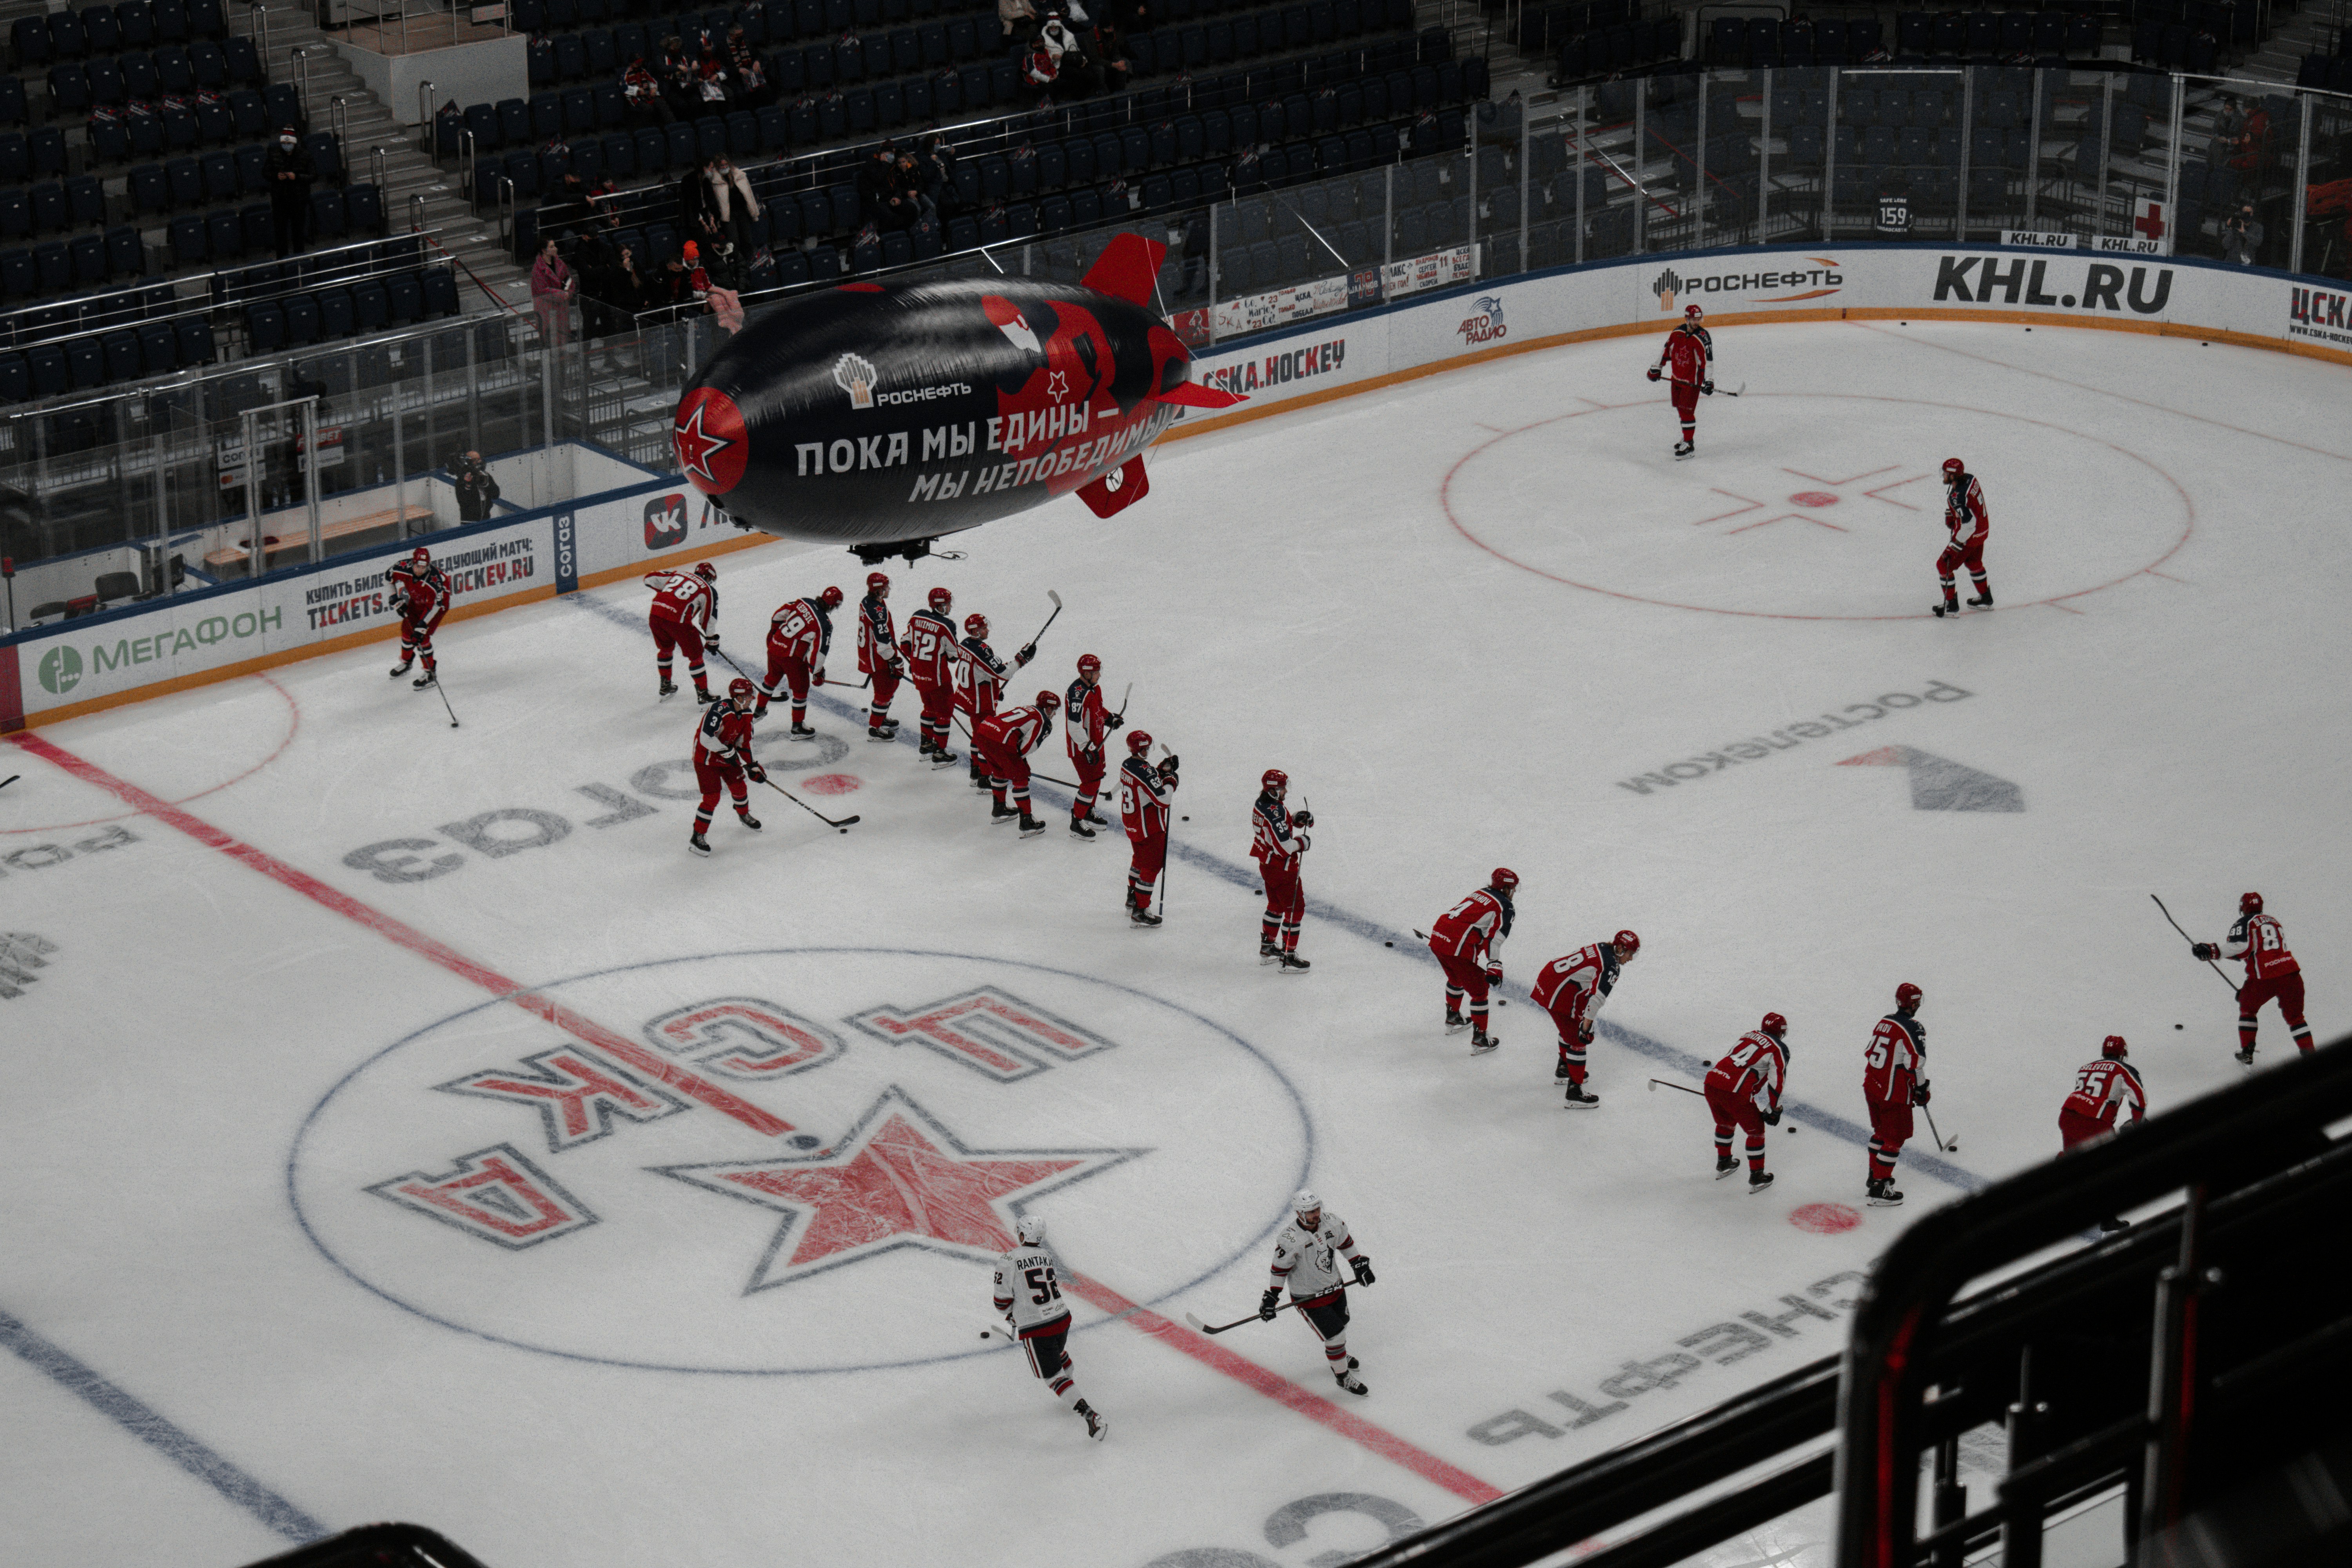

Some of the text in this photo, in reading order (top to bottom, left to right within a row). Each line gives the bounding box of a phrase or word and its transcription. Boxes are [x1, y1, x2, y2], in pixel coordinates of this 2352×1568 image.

[1880, 208, 1906, 225] 159
[2011, 232, 2068, 247] KHL.RU
[2102, 238, 2159, 254] KHL.RU
[1440, 256, 1447, 268] 11
[1686, 270, 1843, 294] РОСНЕФТЬ
[1933, 256, 2173, 314] KHL.RU
[1269, 295, 1278, 303] 23
[1252, 320, 1262, 328] 23
[1457, 315, 1489, 336] АВТО
[1466, 324, 1506, 346] РАДИО
[1203, 339, 1345, 394] CSKA.HOCKEY
[877, 383, 971, 407] РОСНЕФТЬ
[795, 432, 909, 476] ПОКА
[922, 421, 975, 461] МЫ
[986, 401, 1089, 454] ЕДИНЫ
[907, 470, 969, 502] МЫ
[650, 508, 681, 532] VK
[431, 538, 533, 573] ЛЕДУЮЩИЙ МАТЧ:
[558, 516, 573, 577] согаз
[306, 572, 385, 606] КУПИТЬ БИЛЕ
[662, 575, 699, 600] 28
[858, 621, 866, 648] 3
[878, 623, 889, 634] 23
[93, 606, 282, 674] МЕГАФОН
[913, 630, 936, 661] 52
[989, 656, 1002, 668] 50
[958, 660, 970, 688] 0
[1072, 702, 1082, 713] 87
[711, 716, 718, 727] 3
[1150, 777, 1161, 789] 63
[1276, 820, 1288, 833] 35
[1448, 900, 1474, 919] 4
[2230, 926, 2242, 936] 88
[2081, 1063, 2116, 1072] SELEVICH
[2074, 1071, 2107, 1098] 55
[362, 985, 1119, 1252] ЦСКА
[1275, 1245, 1286, 1258] 79
[1016, 1256, 1053, 1270] RANTAKA
[993, 1271, 1003, 1285] 52
[1023, 1268, 1061, 1305] 52
[1316, 1283, 1343, 1298] CCM
